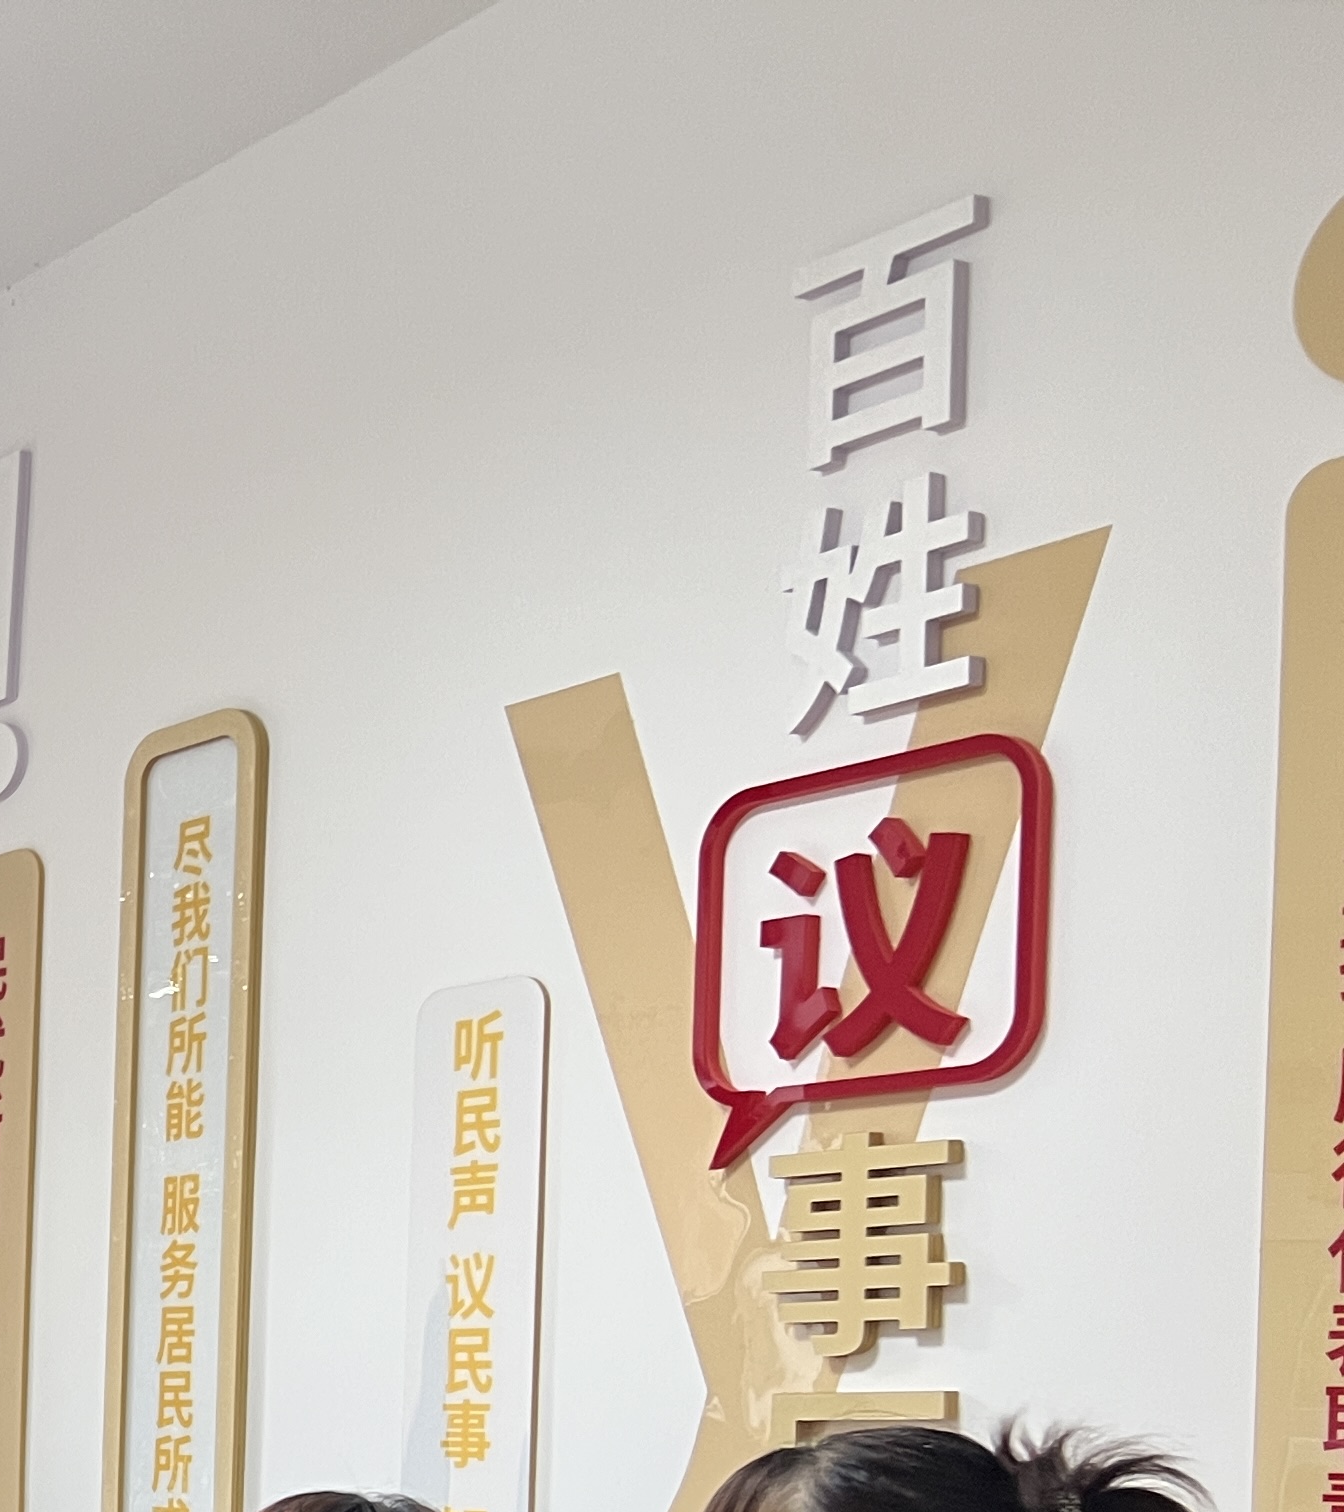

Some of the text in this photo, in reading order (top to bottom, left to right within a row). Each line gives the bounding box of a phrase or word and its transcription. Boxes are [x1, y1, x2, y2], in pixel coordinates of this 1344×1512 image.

[165, 814, 213, 1141] 尽我们所能
[447, 1009, 504, 1231] 听民声
[440, 1252, 495, 1469] 议民事
